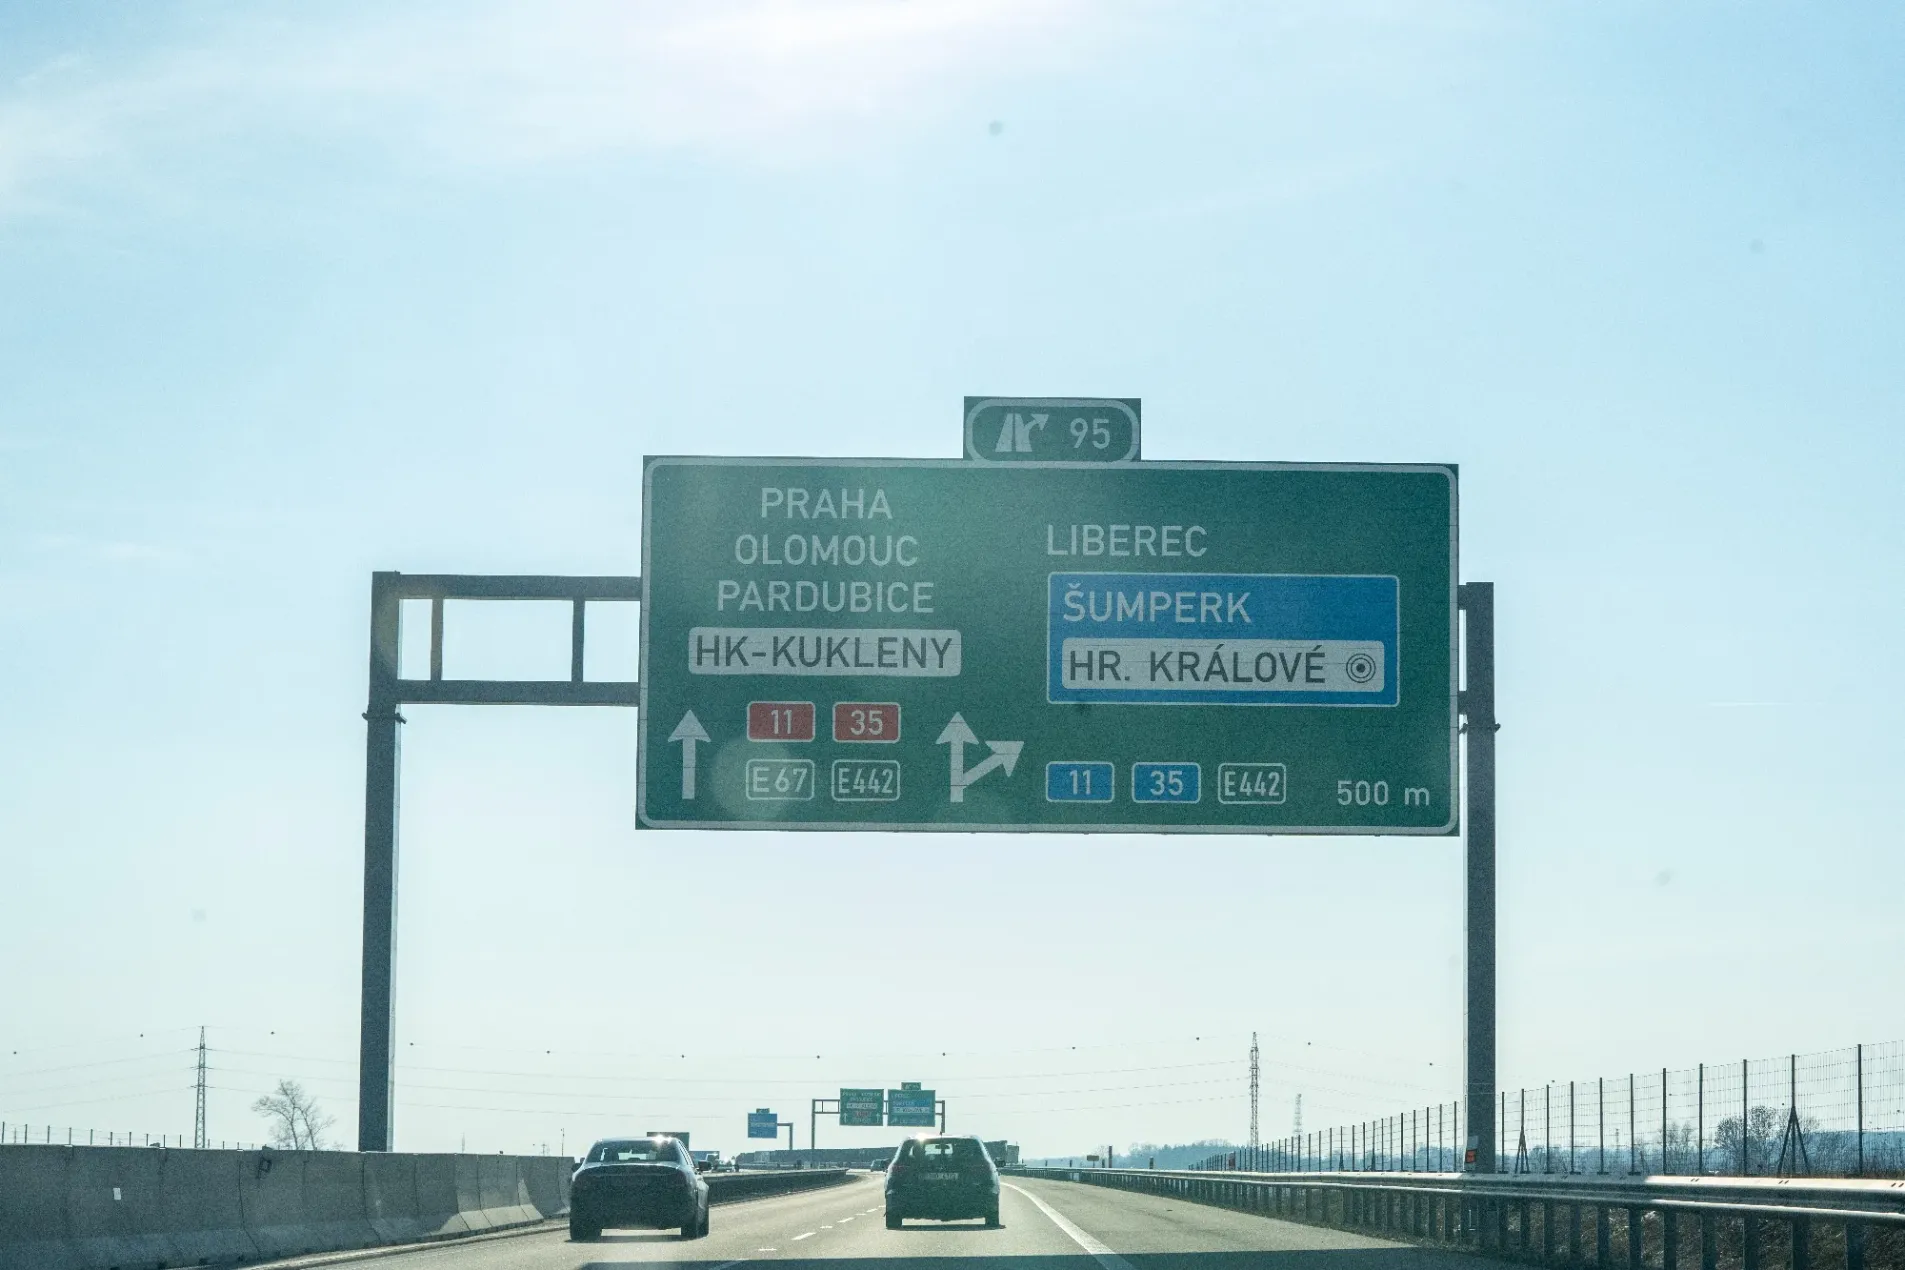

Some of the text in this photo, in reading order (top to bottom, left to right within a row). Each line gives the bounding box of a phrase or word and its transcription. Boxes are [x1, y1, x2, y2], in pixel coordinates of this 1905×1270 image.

[1070, 418, 1110, 449] 95
[761, 487, 893, 519] PRAHA
[734, 534, 919, 566] OLOMOUC
[1047, 524, 1208, 557] LIBEREC
[717, 580, 935, 613] PARDUBICE
[1063, 583, 1252, 623] ŠUMPERK
[695, 635, 953, 669] HK-KUKLENY
[1069, 644, 1326, 684] HR. KRÁLOVÉ
[771, 710, 793, 735] 11
[850, 710, 883, 736] 35
[838, 769, 894, 794] E442
[1069, 770, 1092, 796] 11
[1150, 771, 1184, 797] 35
[1224, 771, 1281, 798] E442
[1336, 780, 1430, 806] 500 m
